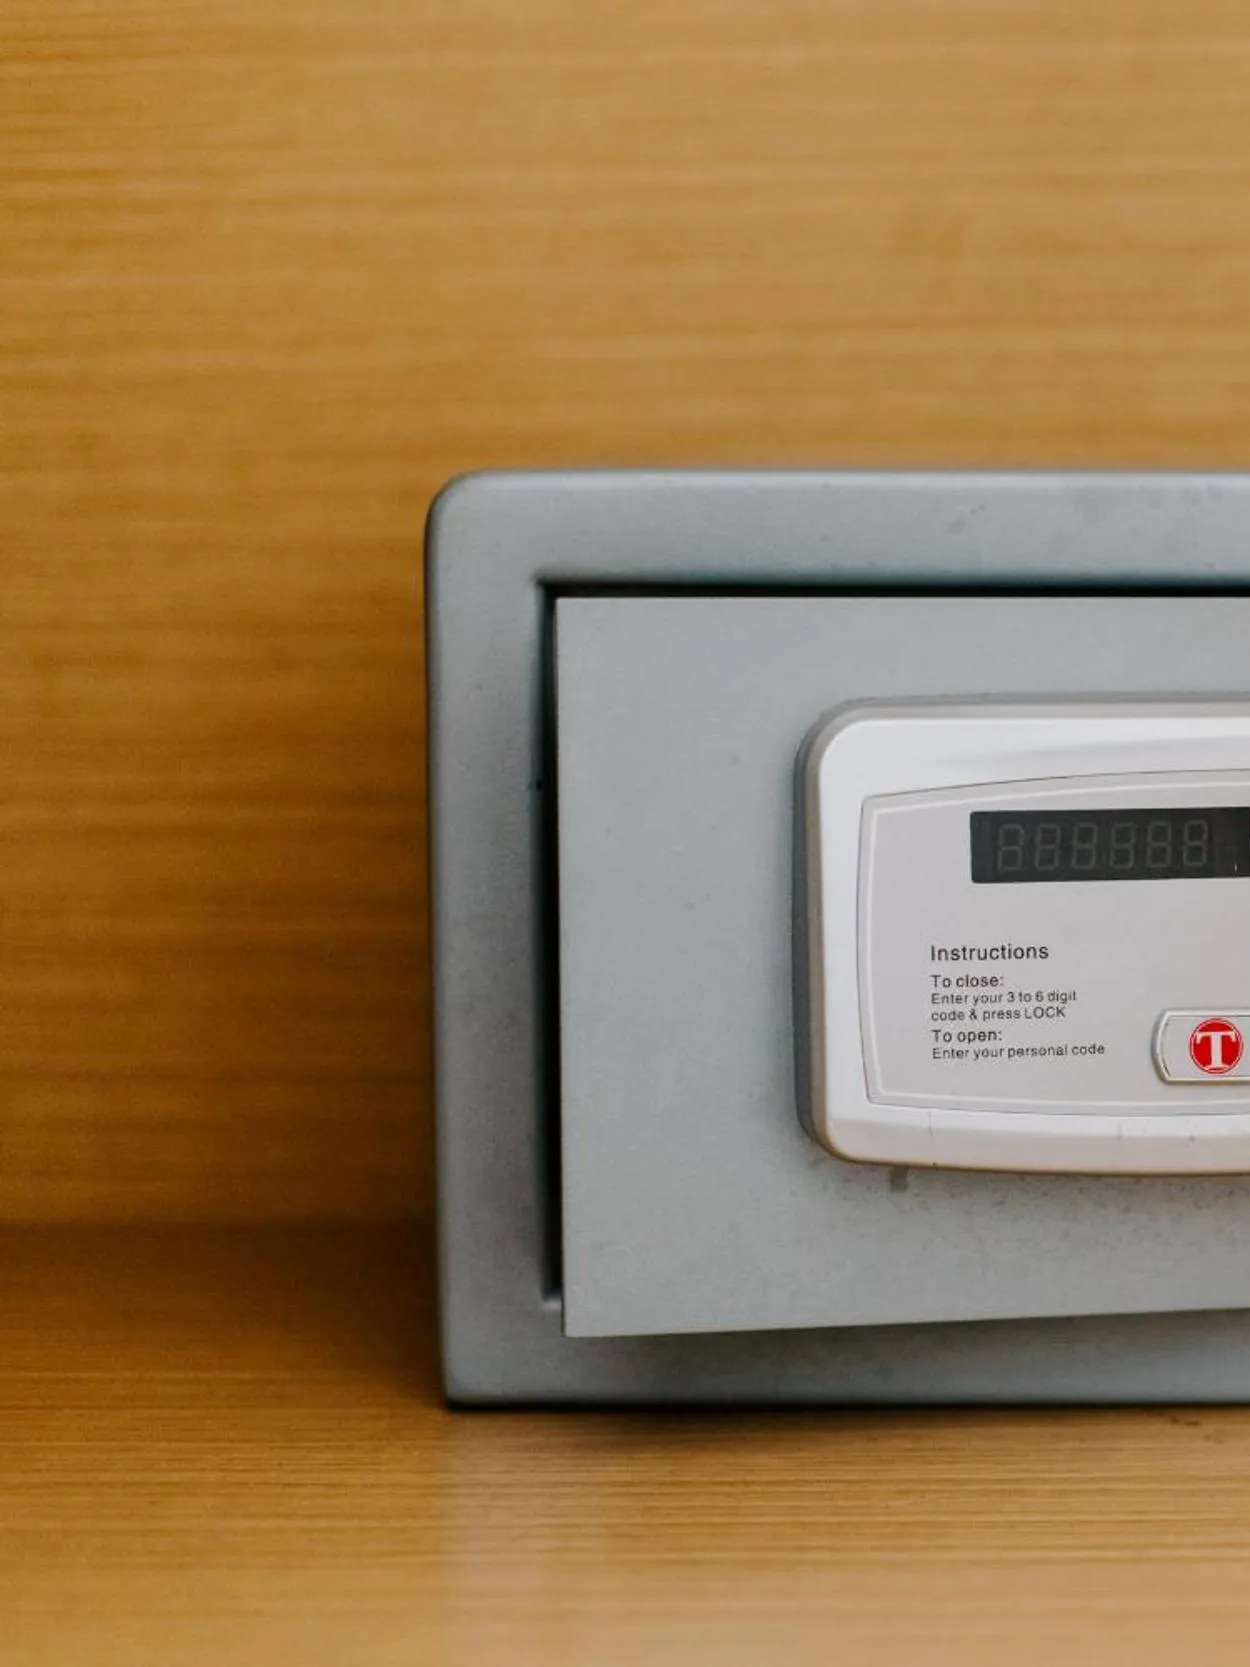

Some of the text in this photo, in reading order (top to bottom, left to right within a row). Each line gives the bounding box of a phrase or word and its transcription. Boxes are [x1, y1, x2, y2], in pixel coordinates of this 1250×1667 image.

[930, 943, 1049, 961] Instructions
[930, 974, 1004, 988] To close:
[931, 990, 1077, 1007] Enter your 3 to 6 digit
[931, 1006, 1066, 1022] code & press LOCK
[931, 1029, 1003, 1044] To open:
[932, 1043, 1106, 1061] Enter your personal code
